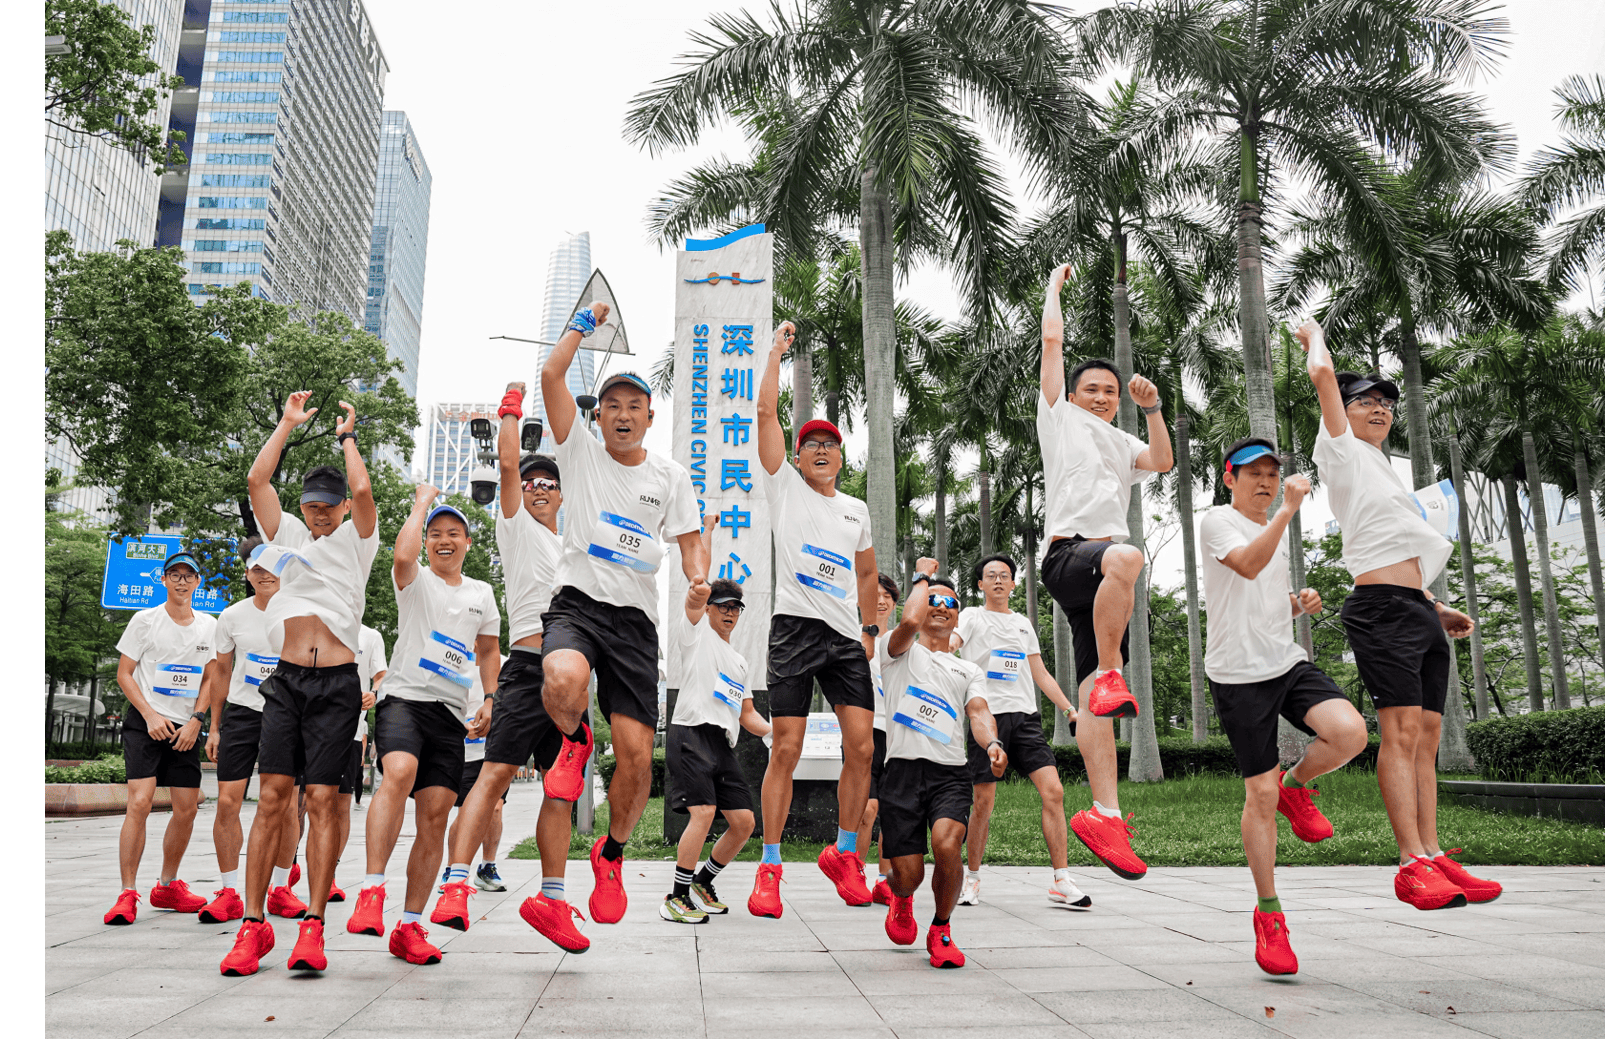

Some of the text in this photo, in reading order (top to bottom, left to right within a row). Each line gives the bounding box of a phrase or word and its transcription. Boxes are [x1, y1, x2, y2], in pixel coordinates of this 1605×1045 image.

[691, 323, 710, 434] SHENZHEN
[718, 324, 753, 585] 深圳市民中心
[619, 533, 641, 548] 035
[819, 563, 836, 577] 001
[117, 583, 154, 597] 海田路
[445, 650, 463, 665] 006
[1004, 660, 1018, 669] 018
[260, 666, 276, 675] 040
[172, 674, 188, 683] 034
[919, 704, 939, 719] 007
